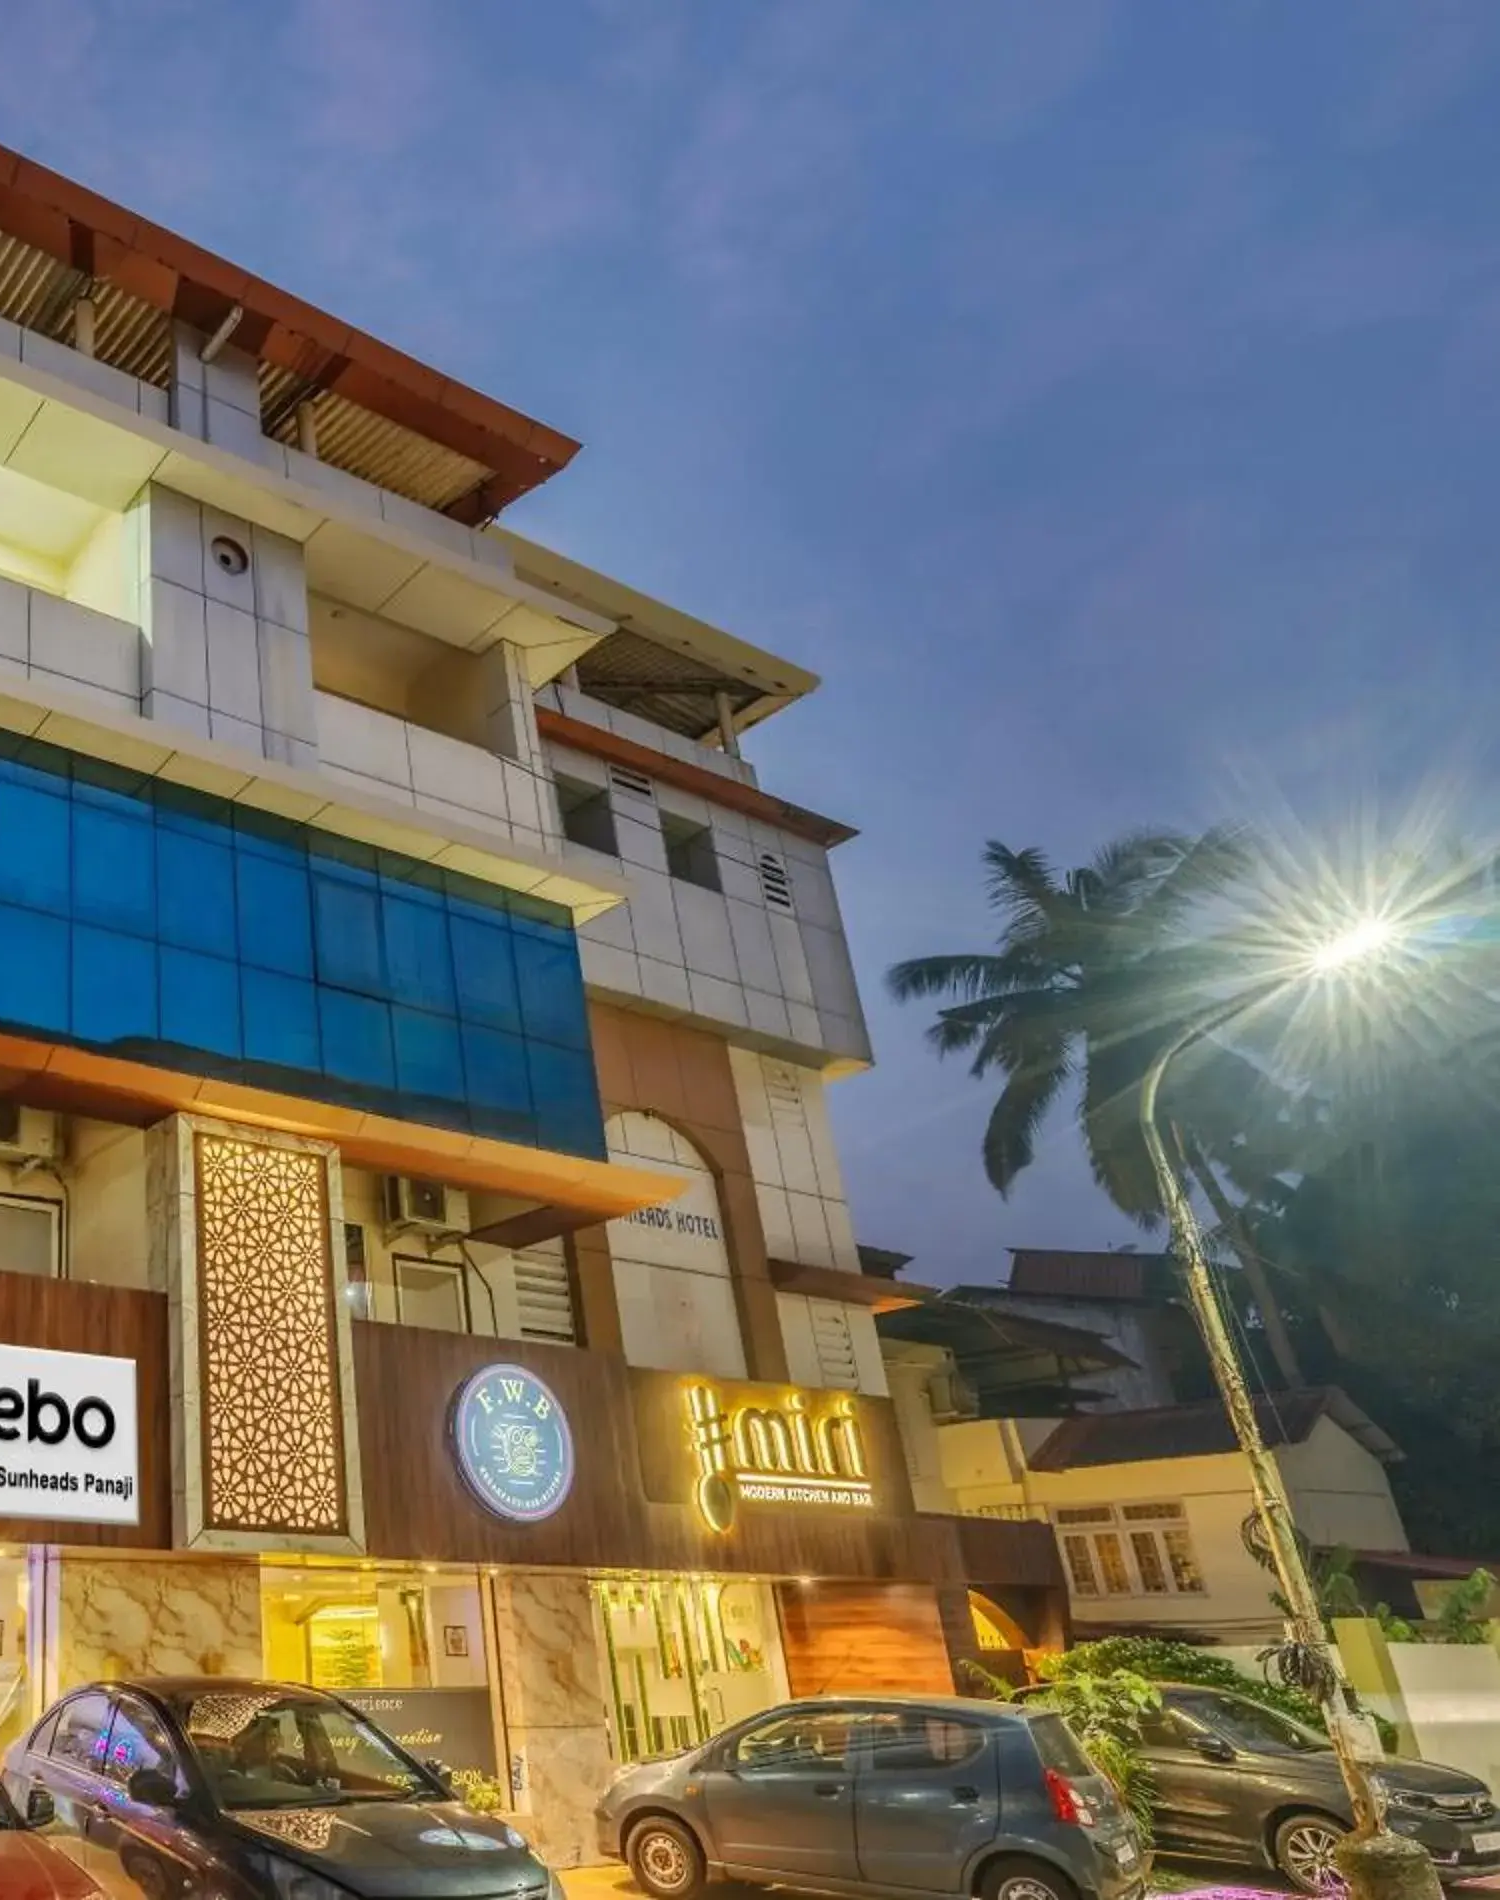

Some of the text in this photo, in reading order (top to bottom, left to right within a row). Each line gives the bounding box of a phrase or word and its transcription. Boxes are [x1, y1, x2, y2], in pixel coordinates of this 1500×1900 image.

[675, 1211, 719, 1240] HOTEL
[84, 1473, 133, 1501] Panaji
[739, 1483, 874, 1506] MODERN KITCHEN AND BAR
